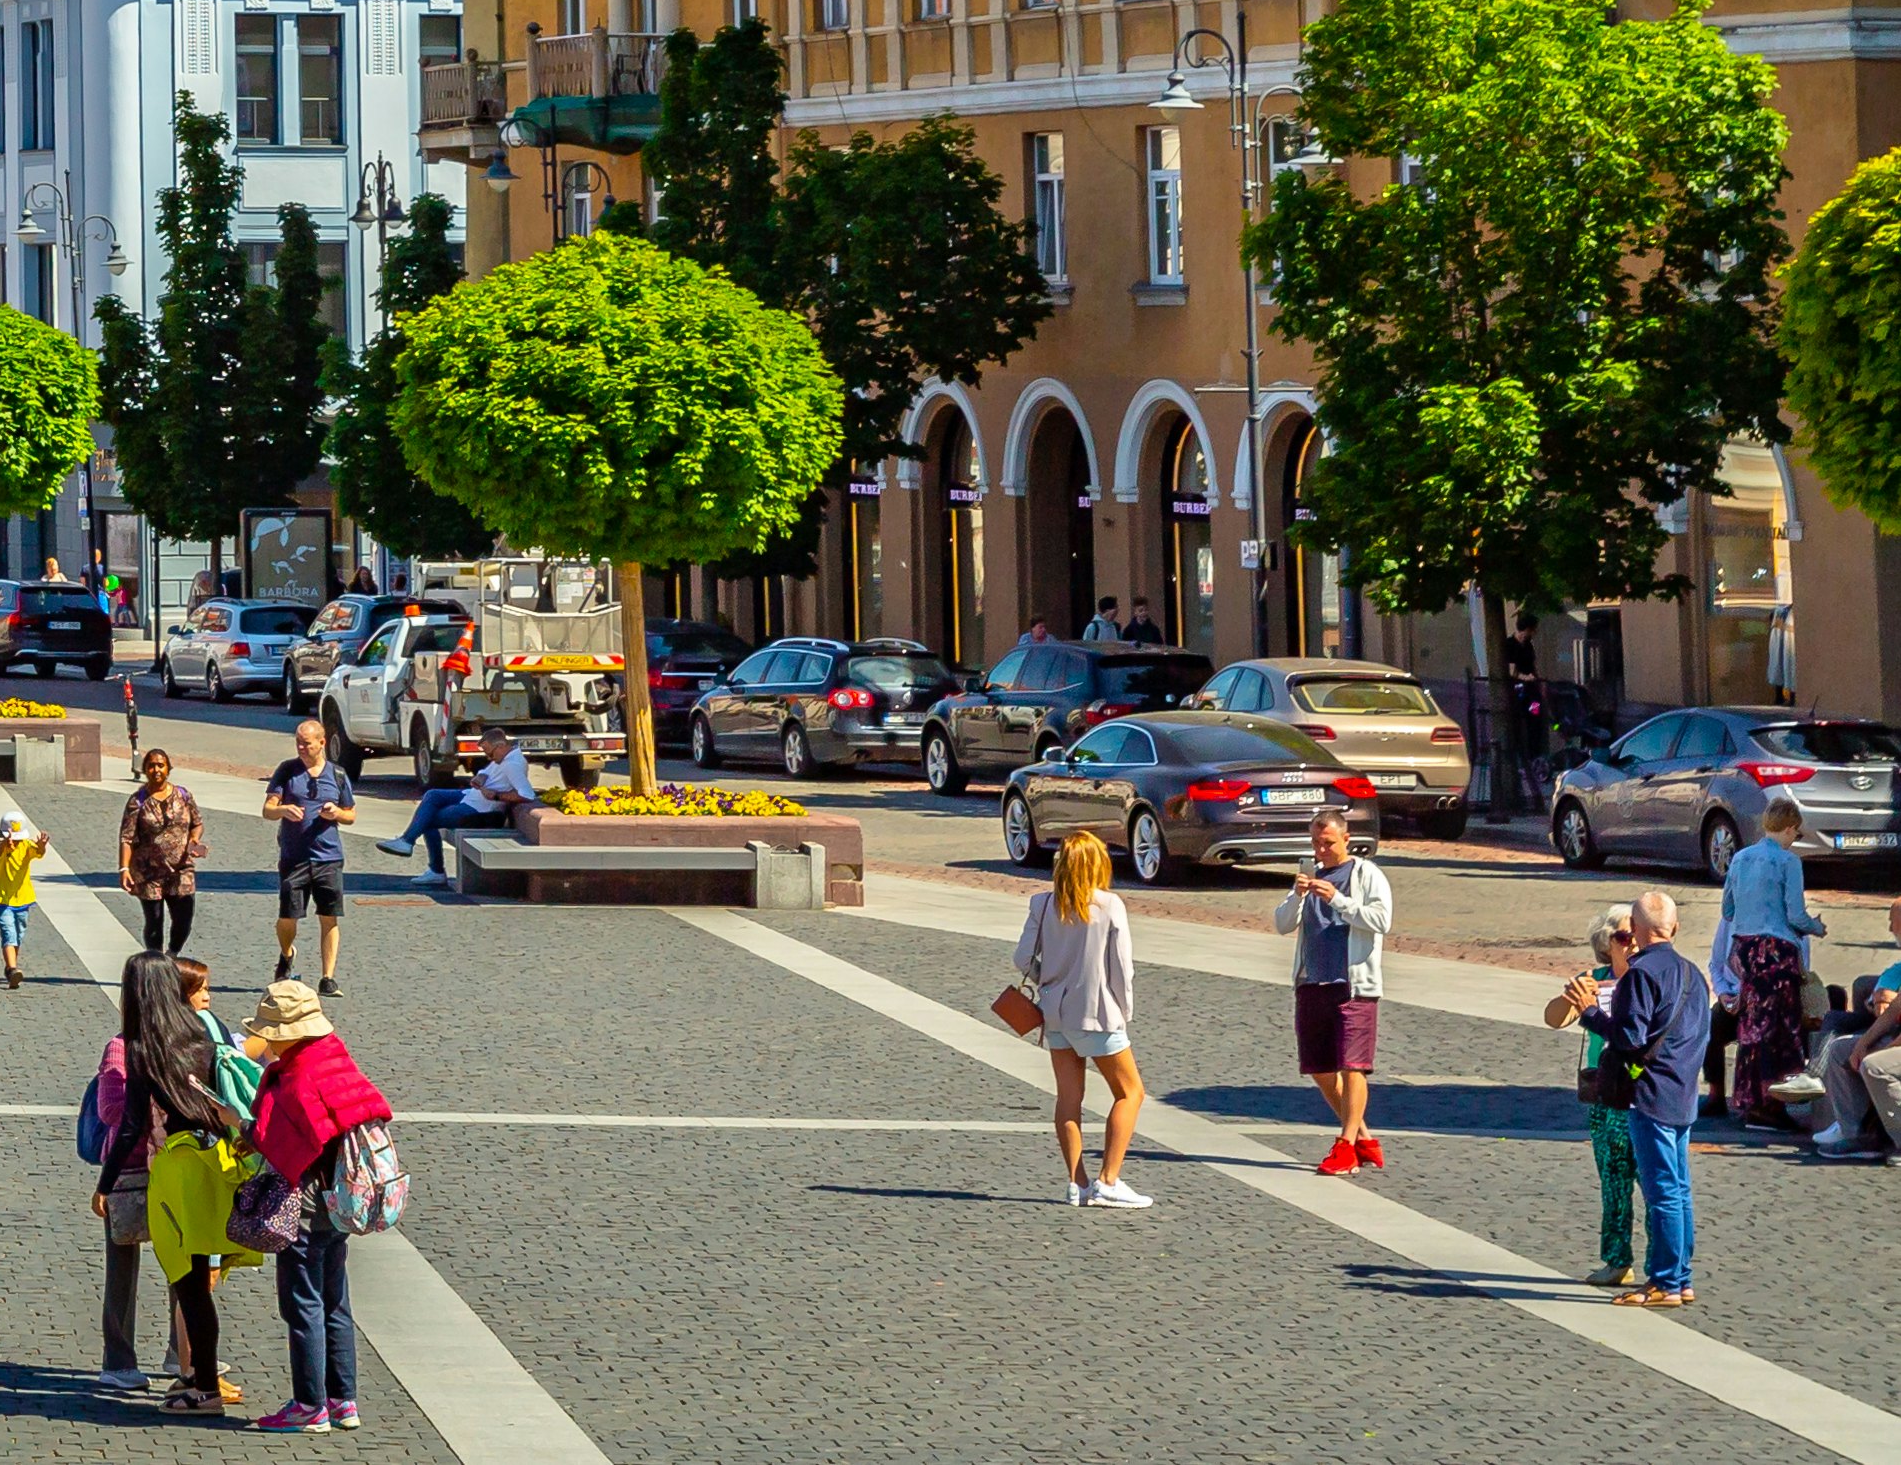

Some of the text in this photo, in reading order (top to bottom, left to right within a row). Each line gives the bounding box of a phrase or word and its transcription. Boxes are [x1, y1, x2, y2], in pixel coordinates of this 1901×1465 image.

[259, 587, 319, 598] BARBORA
[546, 656, 590, 664] PALFINGER
[1269, 790, 1294, 802] GBP
